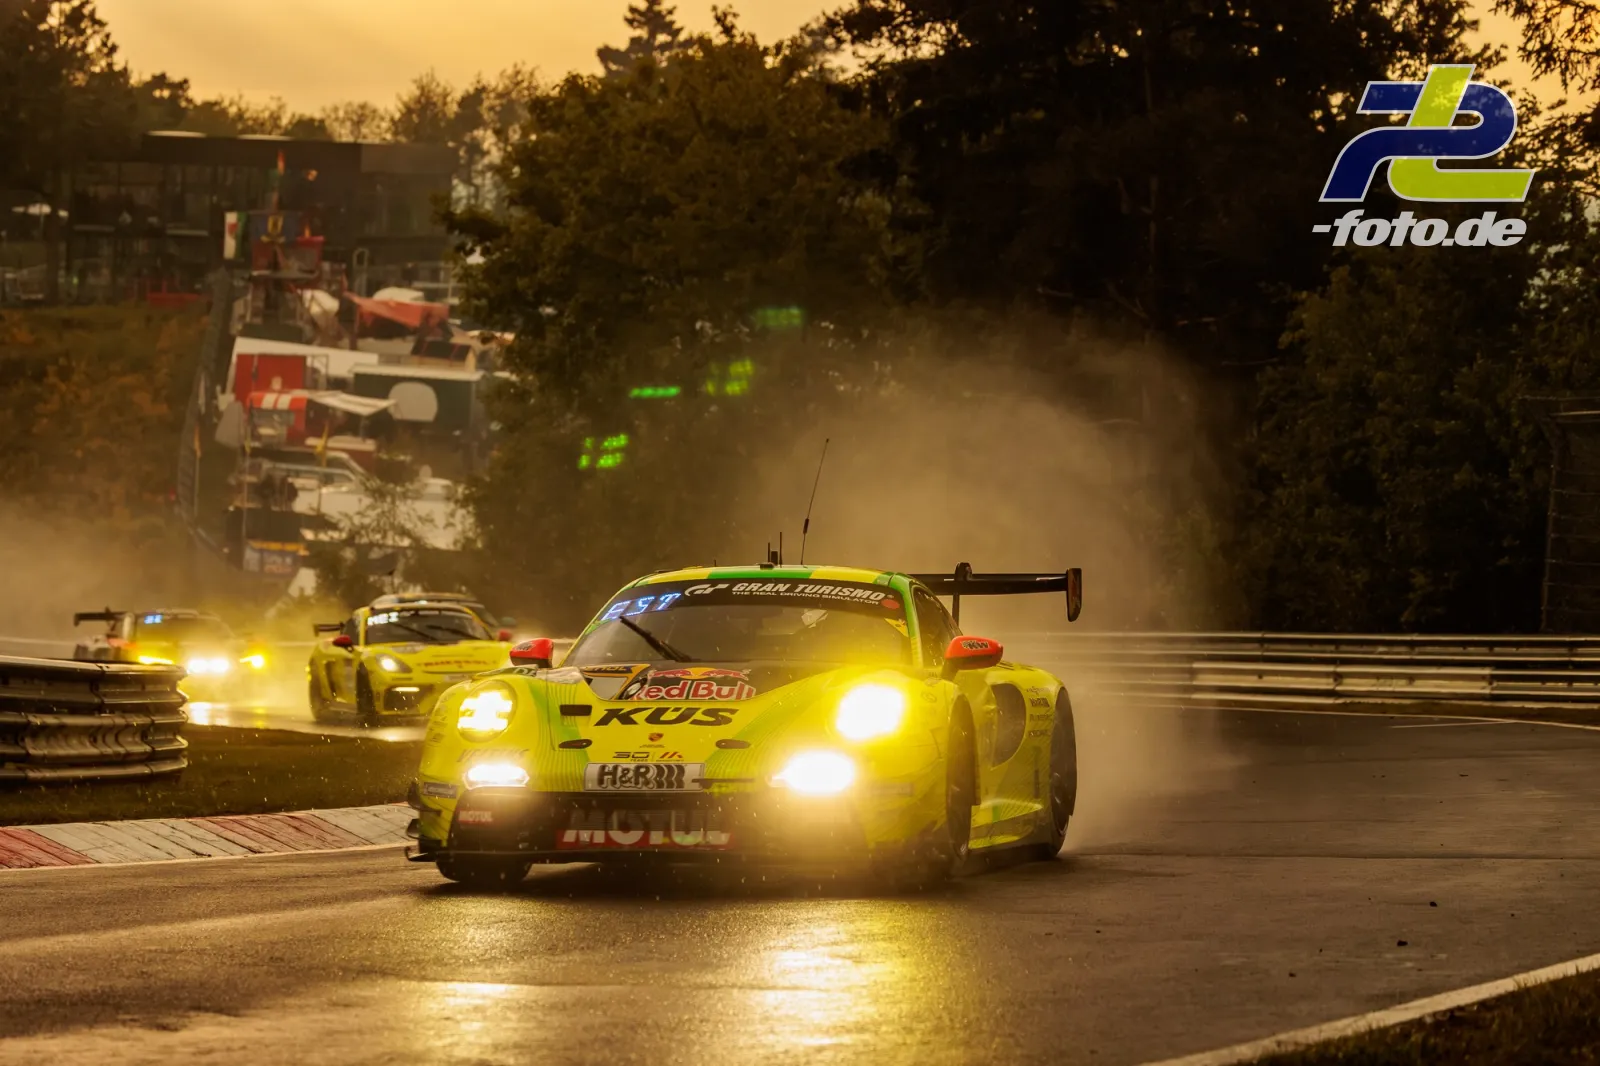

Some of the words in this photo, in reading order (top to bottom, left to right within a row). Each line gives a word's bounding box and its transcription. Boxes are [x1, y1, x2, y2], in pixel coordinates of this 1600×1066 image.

[732, 583, 791, 592] GRAN
[794, 584, 880, 601] TURISMO
[822, 594, 879, 605] SIMULATOR
[691, 680, 756, 700] Bull
[594, 707, 739, 726] KÜS
[597, 764, 652, 789] H&R
[562, 810, 731, 846] MOTUL
